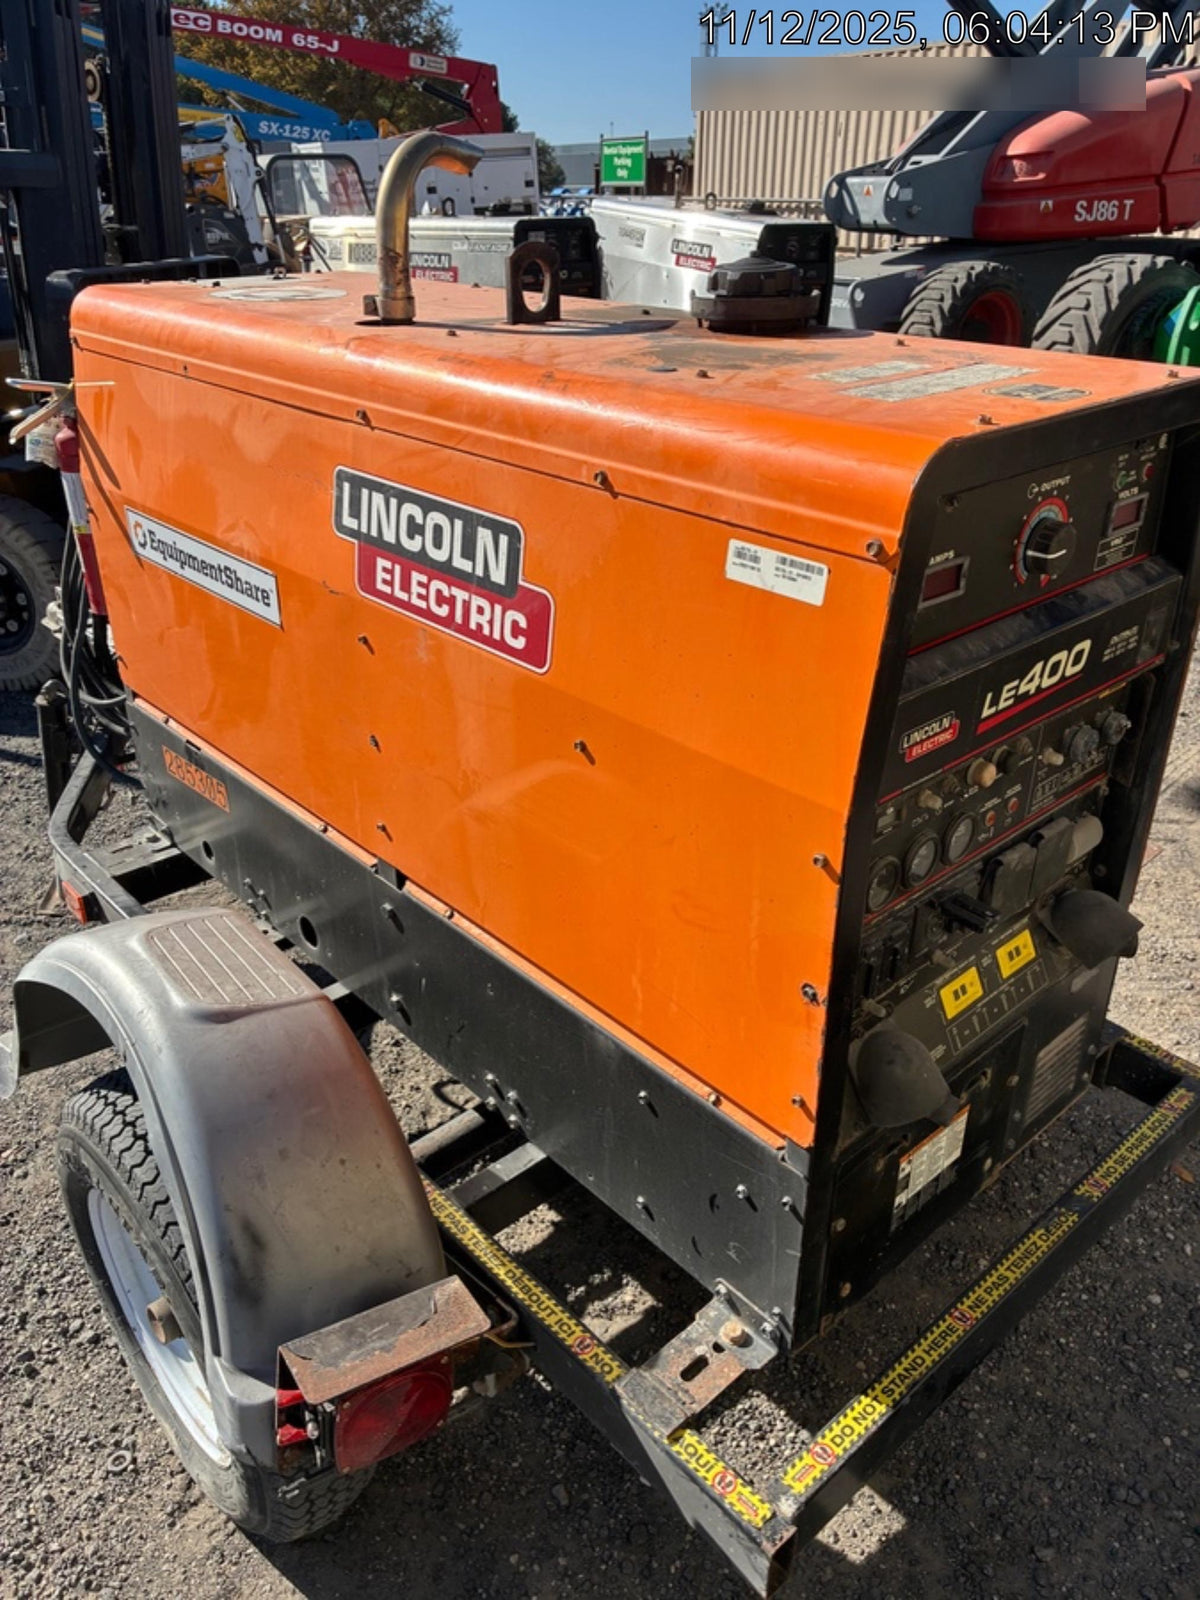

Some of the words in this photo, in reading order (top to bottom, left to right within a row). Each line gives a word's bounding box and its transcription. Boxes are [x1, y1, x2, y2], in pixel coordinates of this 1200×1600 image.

[217, 19, 282, 43] BOOM
[292, 33, 340, 53] 65-J
[258, 121, 310, 140] SX-125
[312, 128, 331, 142] XC
[1074, 199, 1118, 222] SJ86
[1123, 199, 1134, 221] T
[674, 240, 711, 257] LINCOLN
[415, 270, 455, 282] ELECTRIC
[341, 480, 510, 586] LINCOLN
[148, 529, 272, 608] EquipmentShare
[928, 549, 954, 566] AMPS
[374, 556, 528, 651] ELECTRIC
[981, 639, 1092, 719] LE400
[902, 714, 951, 748] LINCOLN
[911, 728, 955, 758] ELECTRIC
[432, 1197, 447, 1212] NE
[444, 1212, 470, 1234] PAS
[467, 1232, 507, 1267] TENEZ
[555, 1318, 577, 1337] ICI
[967, 1294, 989, 1313] NE
[983, 1273, 1009, 1296] PAS
[1005, 1241, 1041, 1275] TENEZ
[589, 1352, 614, 1375] NO
[830, 1424, 855, 1447] DO
[852, 1395, 882, 1426] NOT
[881, 1354, 926, 1398] STAND
[922, 1322, 960, 1357] HERE
